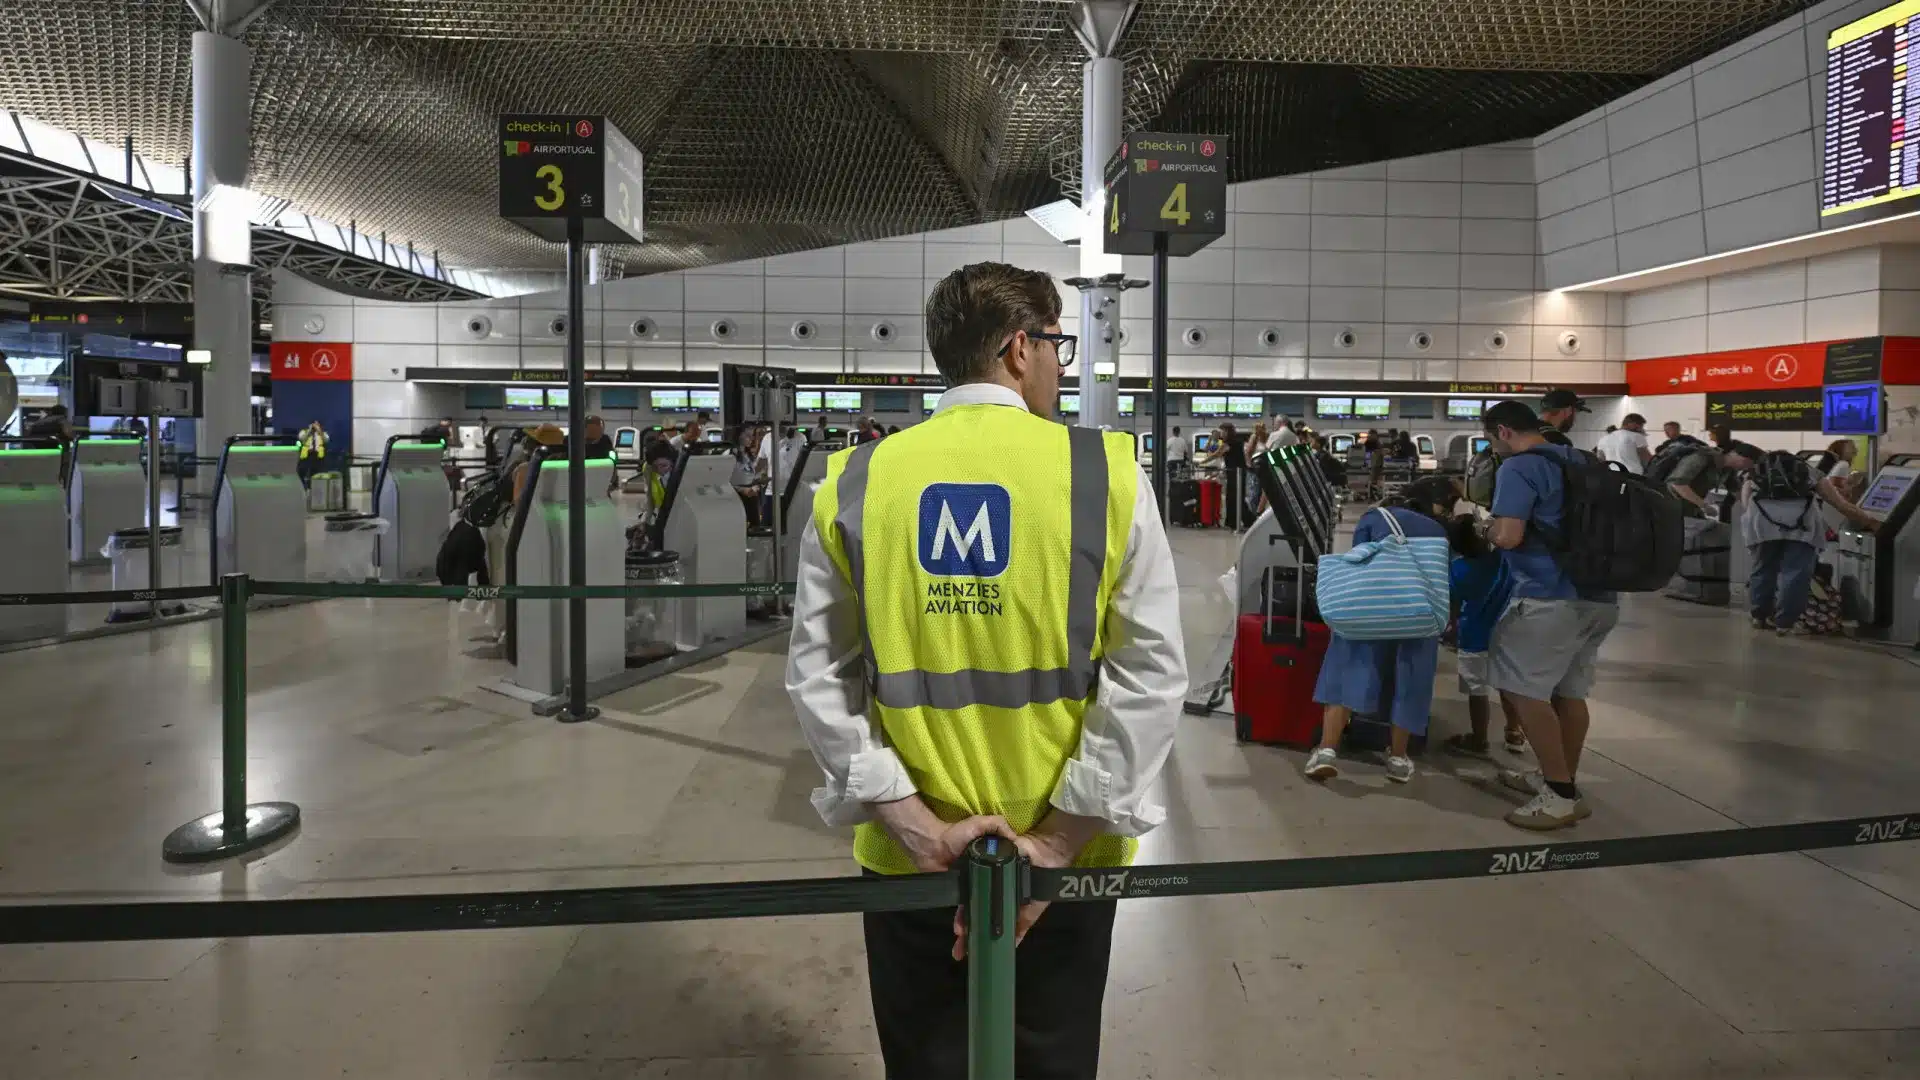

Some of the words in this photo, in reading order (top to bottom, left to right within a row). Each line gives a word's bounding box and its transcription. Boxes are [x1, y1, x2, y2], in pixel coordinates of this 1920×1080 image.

[506, 121, 561, 133] check-in
[1137, 140, 1187, 151] check-in
[534, 165, 565, 211] 3
[618, 181, 630, 226] 3
[1160, 183, 1190, 225] 4
[1110, 193, 1119, 235] 4
[318, 353, 331, 369] A
[1774, 359, 1789, 375] A
[930, 499, 996, 562] M
[928, 583, 1000, 598] MENZIES
[925, 600, 1002, 616] AVIATION
[1550, 851, 1600, 863] Aeroportos
[1130, 875, 1189, 887] Aeroportos
